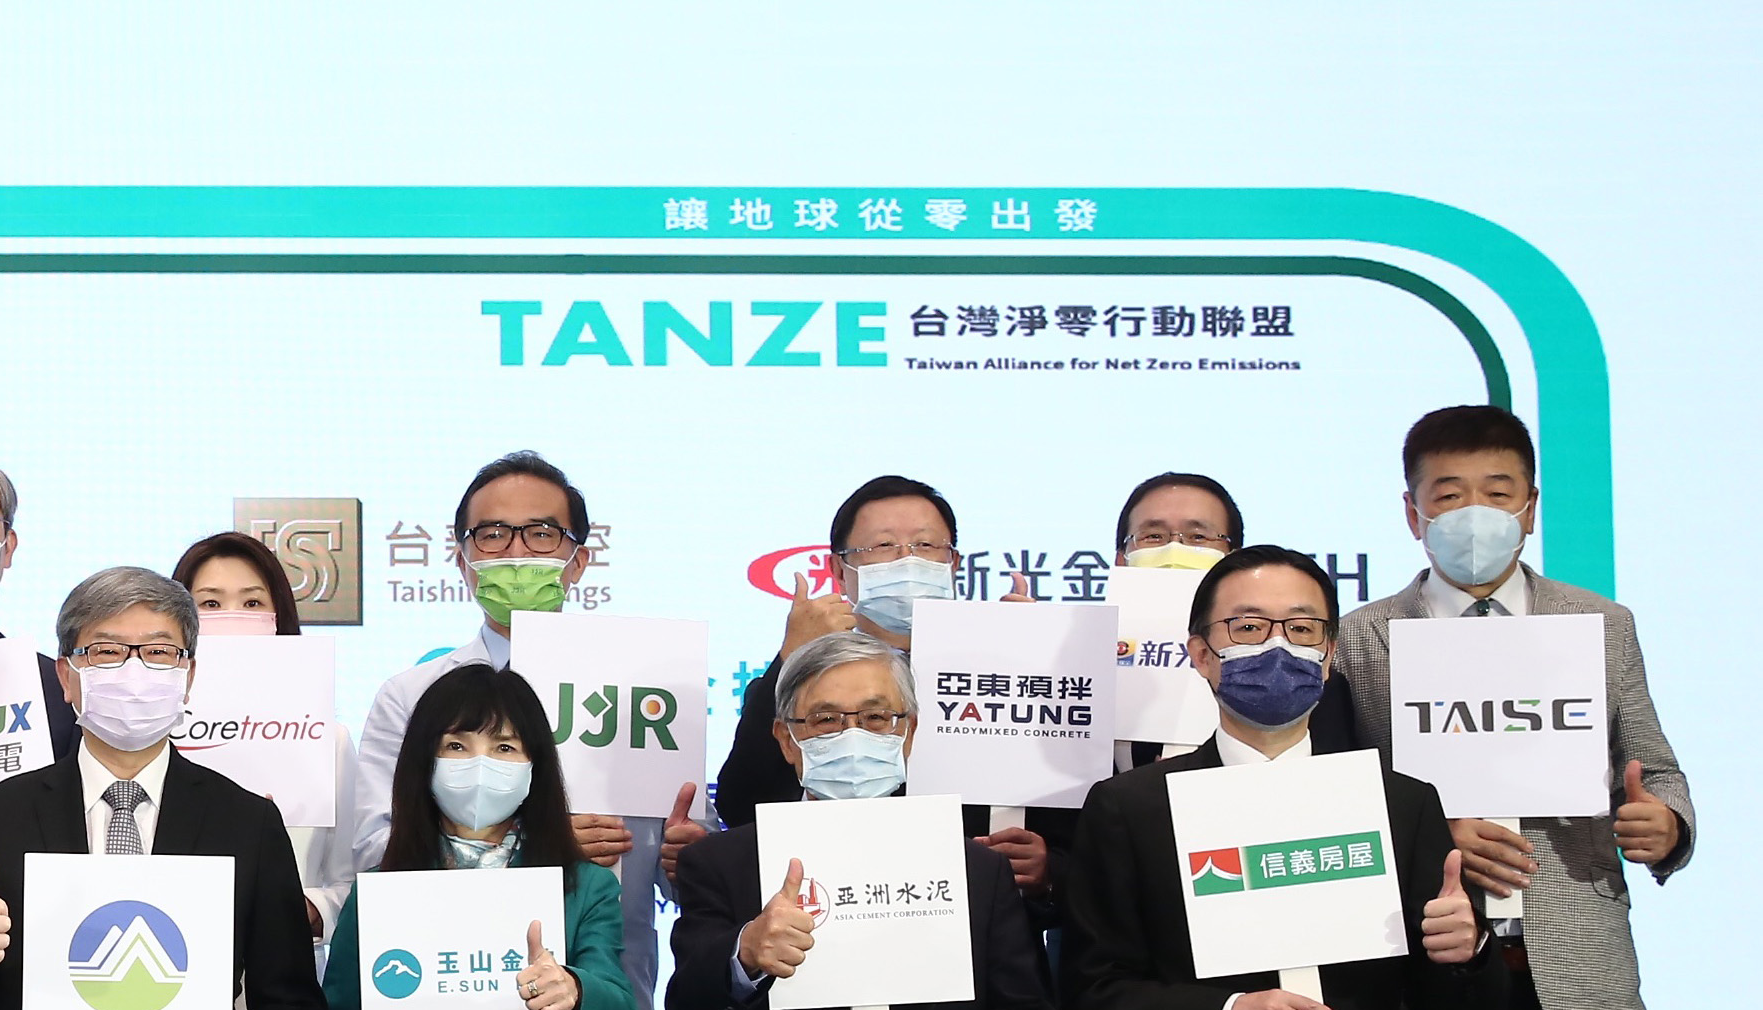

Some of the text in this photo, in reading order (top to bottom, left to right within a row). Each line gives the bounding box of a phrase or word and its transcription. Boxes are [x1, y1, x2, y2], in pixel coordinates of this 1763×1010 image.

[662, 197, 1100, 233] 讓地球從零出發
[481, 301, 888, 367] TANZE
[909, 304, 1296, 338] 台灣淨零行動聯盟
[905, 357, 1301, 371] Taiwan Alliance for Net Zero Emissions
[387, 578, 472, 603] Taishi
[936, 672, 1093, 701] 亞東預拌
[936, 701, 1092, 726] YATUNG
[1404, 698, 1593, 734] TAISE
[936, 725, 1091, 739] READYMIXED CONCRETE
[1259, 842, 1375, 879] 信義房屋
[834, 879, 954, 907] 亞洲水泥
[834, 908, 955, 921] ASIA CEMENT CORPORATION
[437, 948, 524, 974] 玉山金
[437, 979, 499, 993] E.SUN
